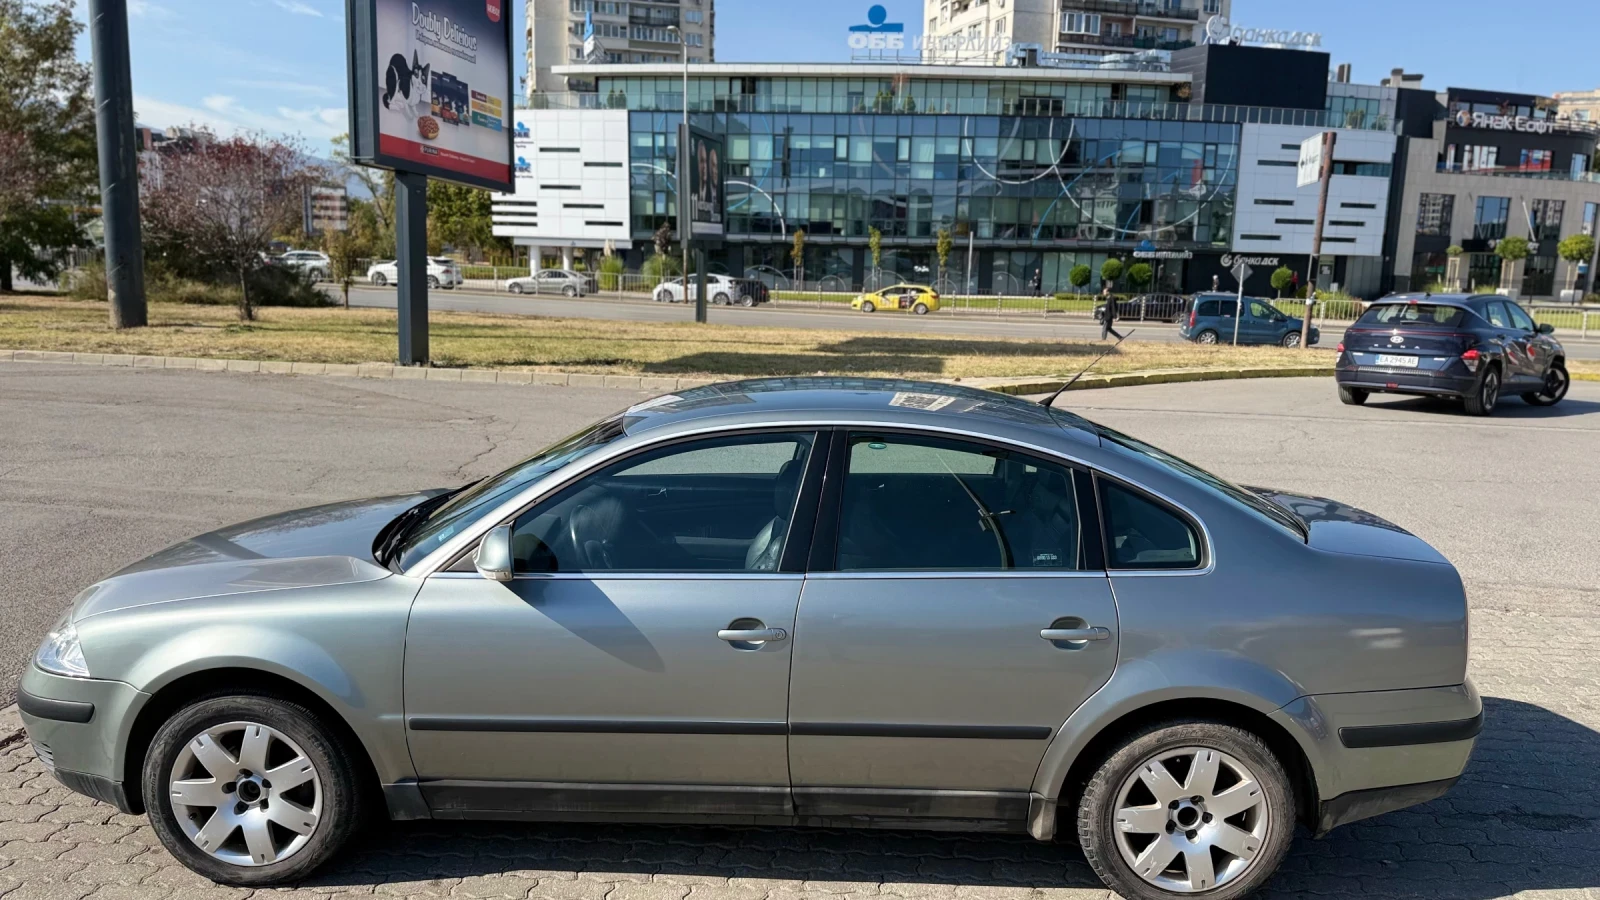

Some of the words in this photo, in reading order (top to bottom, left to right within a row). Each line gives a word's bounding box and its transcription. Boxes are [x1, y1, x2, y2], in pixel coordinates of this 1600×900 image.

[412, 2, 441, 40] Doubly
[443, 17, 477, 51] Delicious
[848, 33, 904, 50] ОББ
